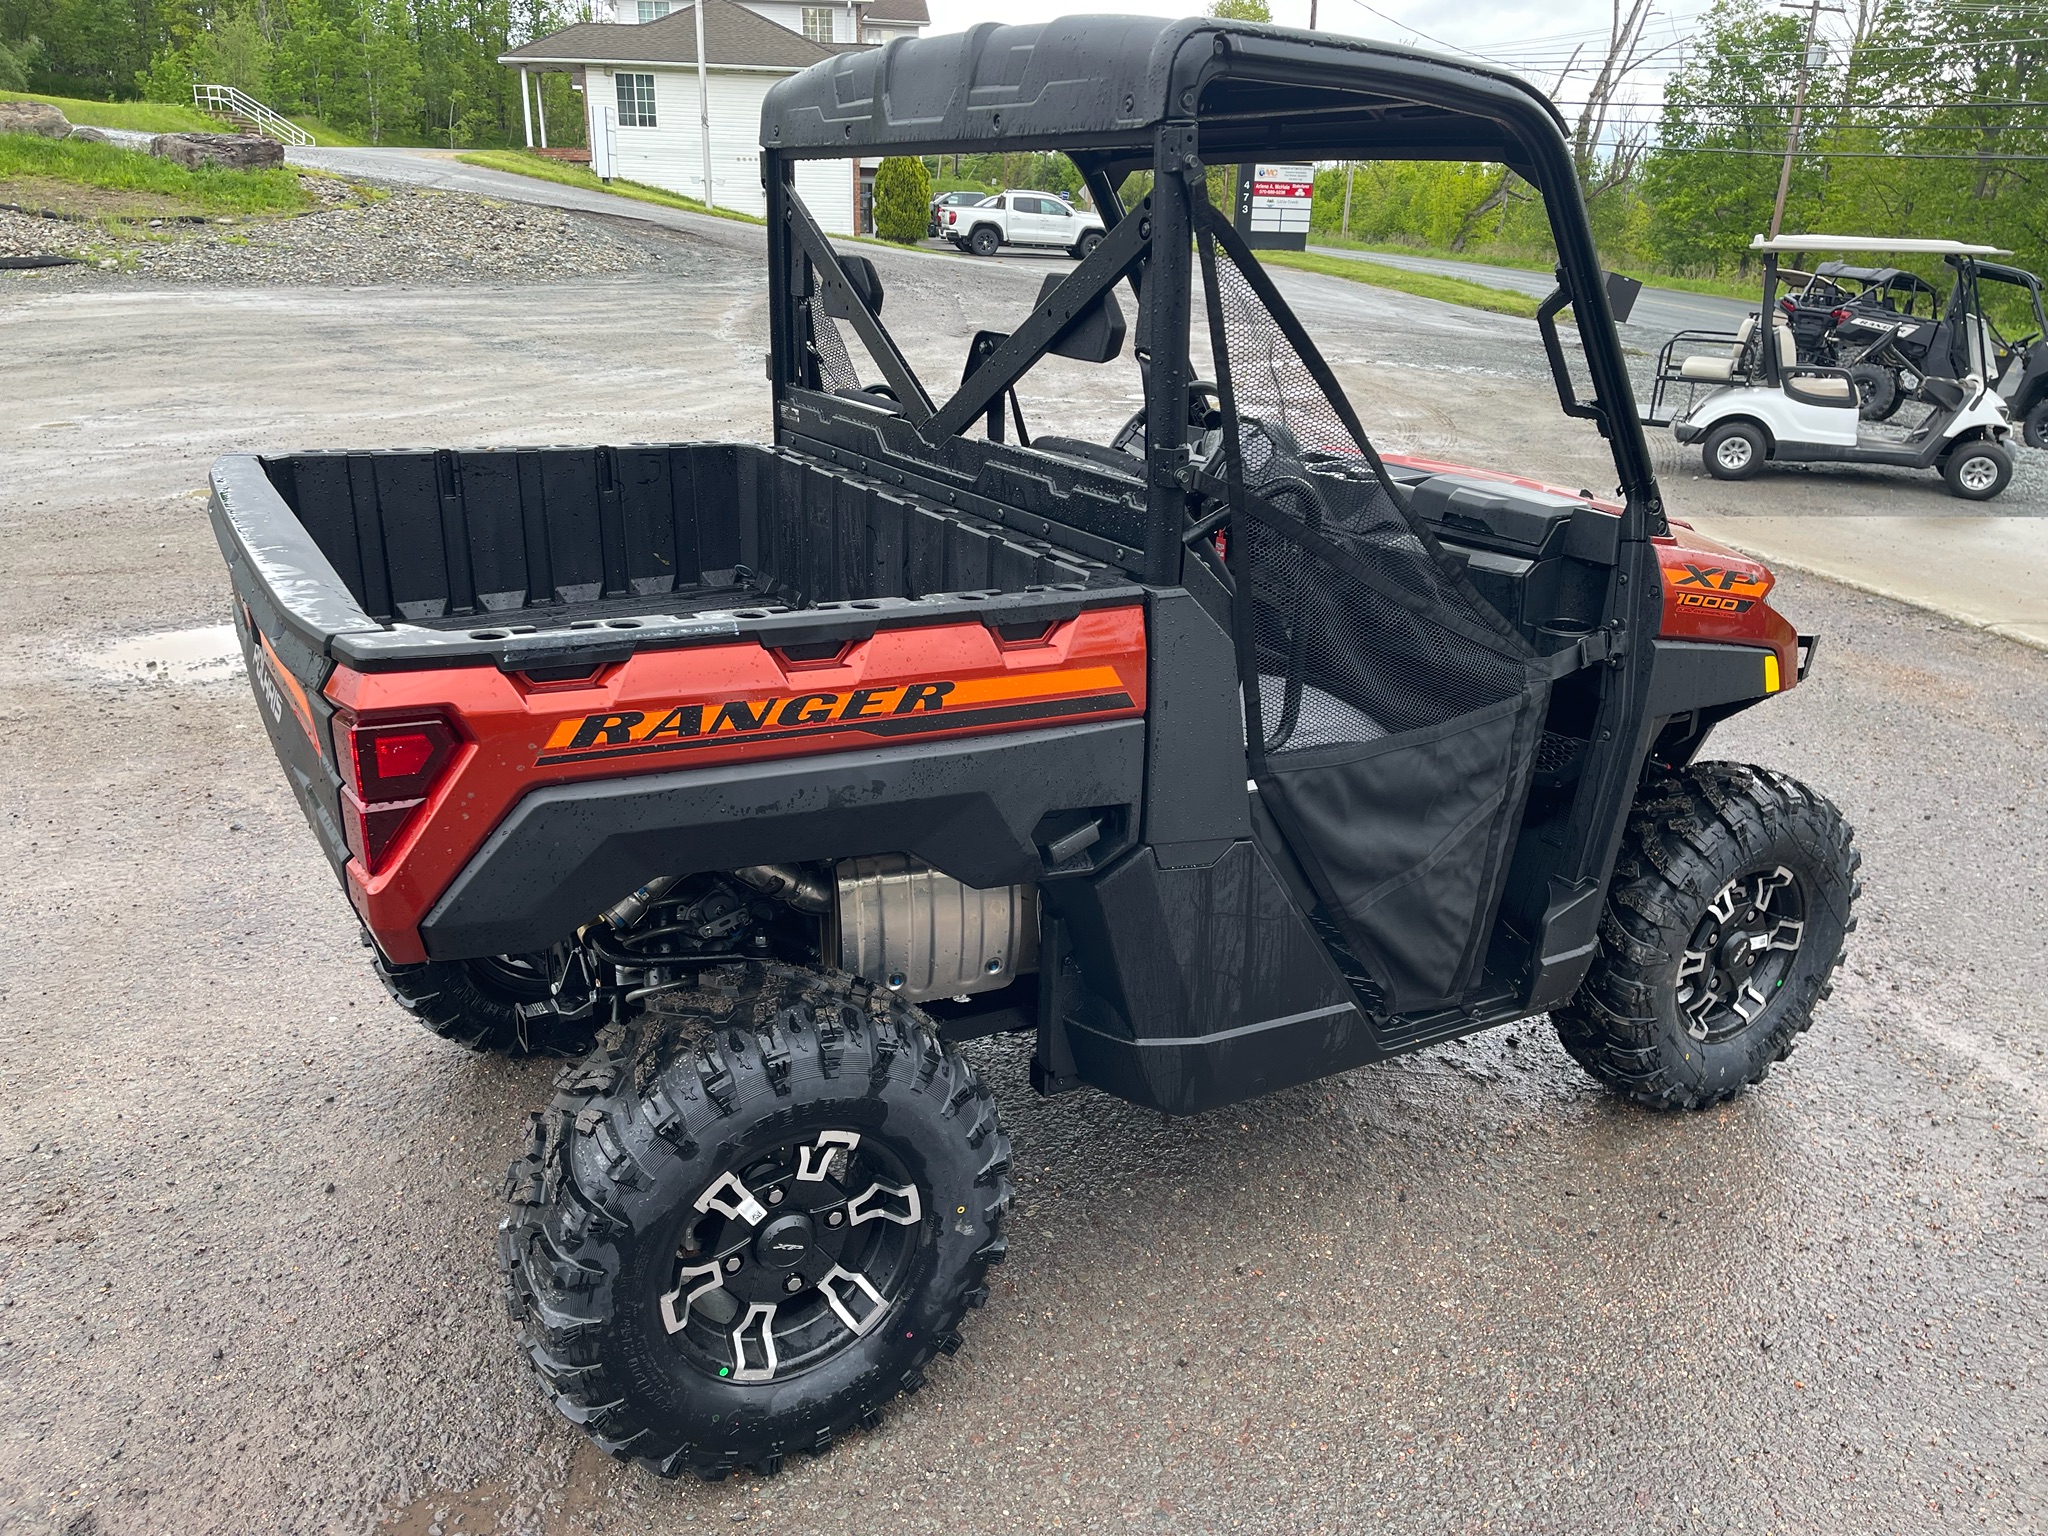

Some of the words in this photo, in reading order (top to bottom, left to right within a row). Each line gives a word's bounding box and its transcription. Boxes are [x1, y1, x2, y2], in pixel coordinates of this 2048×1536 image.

[1859, 320, 1905, 332] RANGR
[1675, 564, 1759, 590] XP
[1676, 592, 1739, 611] 1000
[252, 643, 284, 724] POLARIS
[568, 681, 955, 749] RANGER
[773, 1243, 804, 1251] XP
